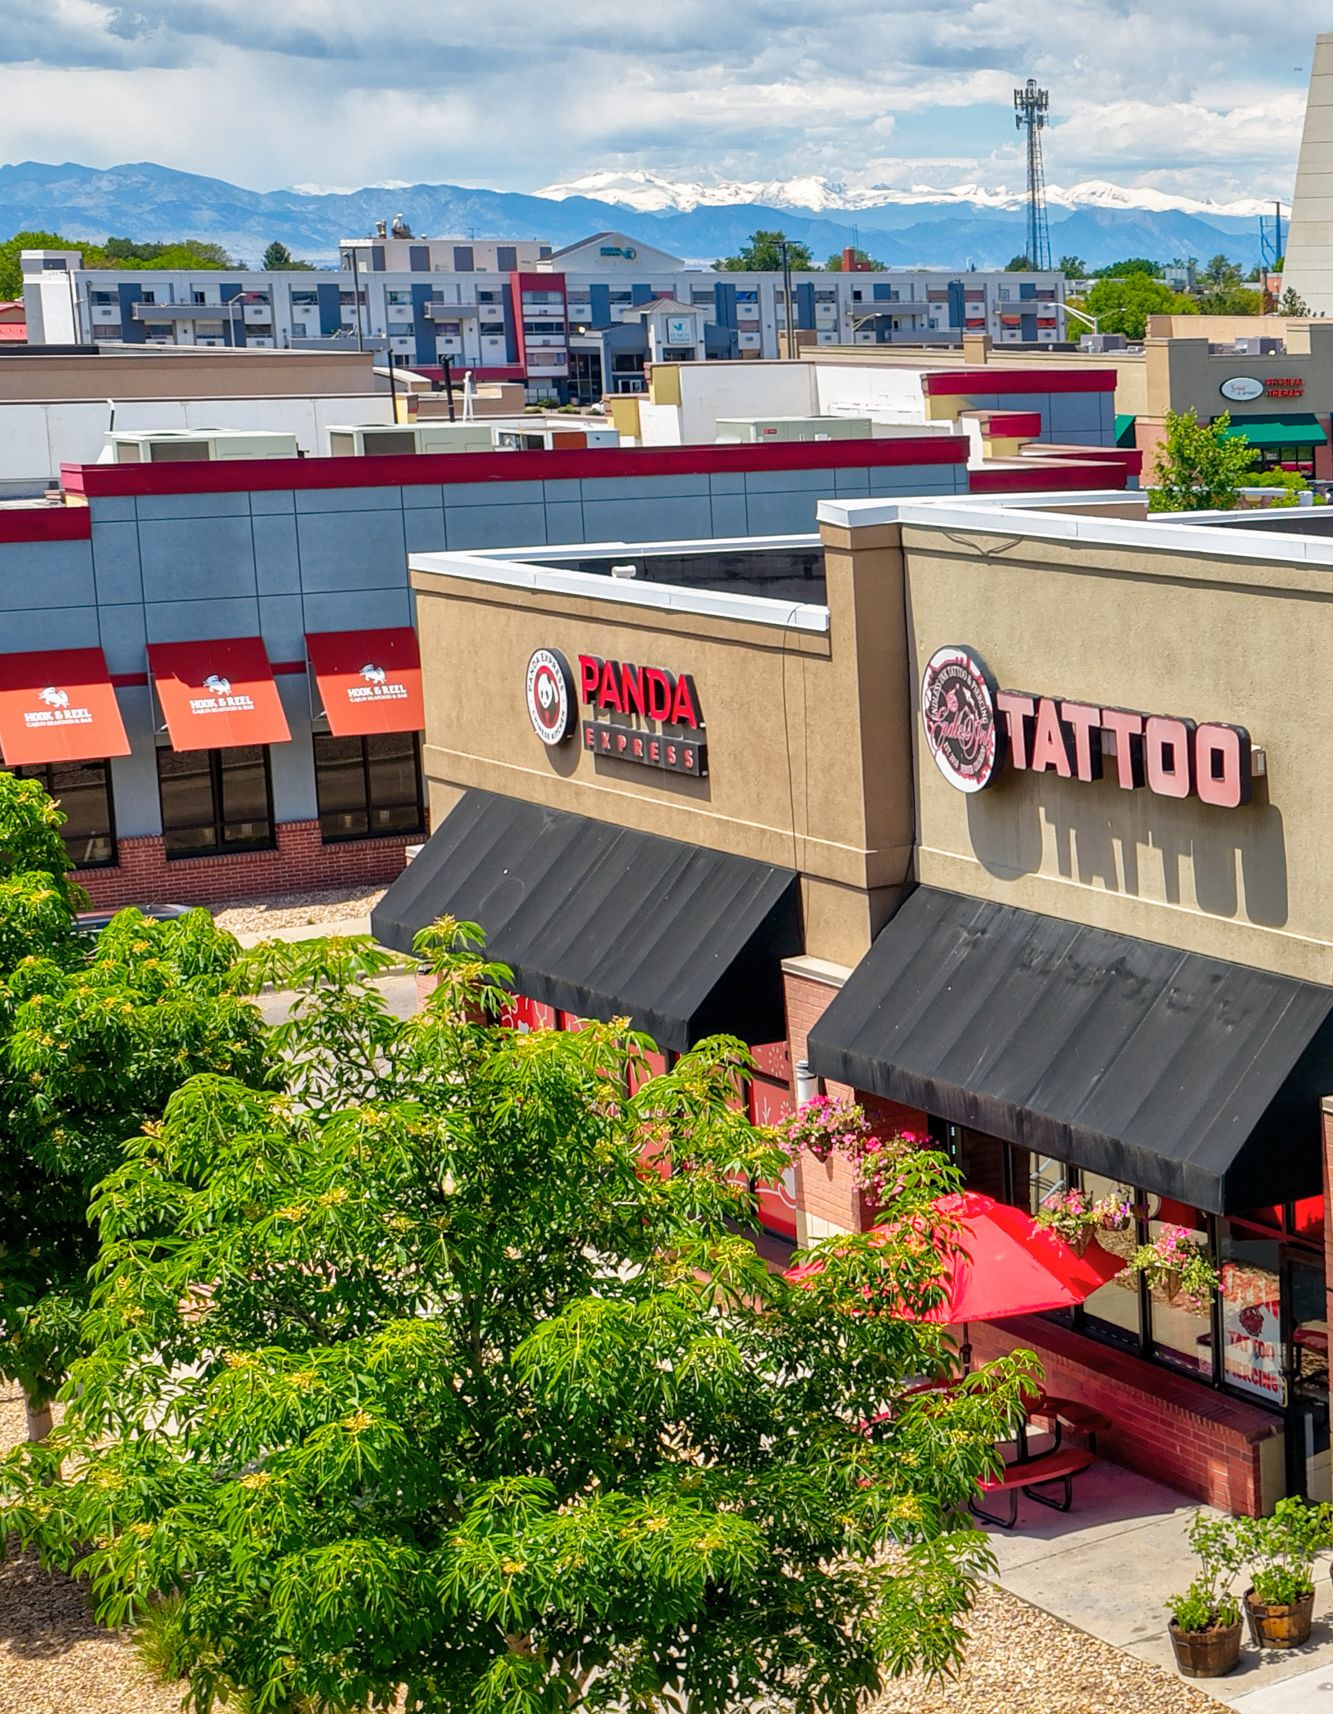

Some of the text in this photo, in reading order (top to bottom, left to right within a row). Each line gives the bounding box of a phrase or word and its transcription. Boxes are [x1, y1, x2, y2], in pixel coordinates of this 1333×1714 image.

[346, 686, 374, 699] HOOK
[381, 684, 407, 695] REEL
[528, 652, 564, 692] PANDA EXPRESS
[578, 654, 700, 730] PANDA
[24, 711, 54, 723] HOOK
[63, 708, 92, 719] REEL
[189, 698, 218, 709] HOOK
[226, 695, 254, 706] REEL
[970, 680, 989, 724] PIERCING
[585, 727, 694, 769] EXPRESS
[996, 689, 1246, 809] TATTOO
